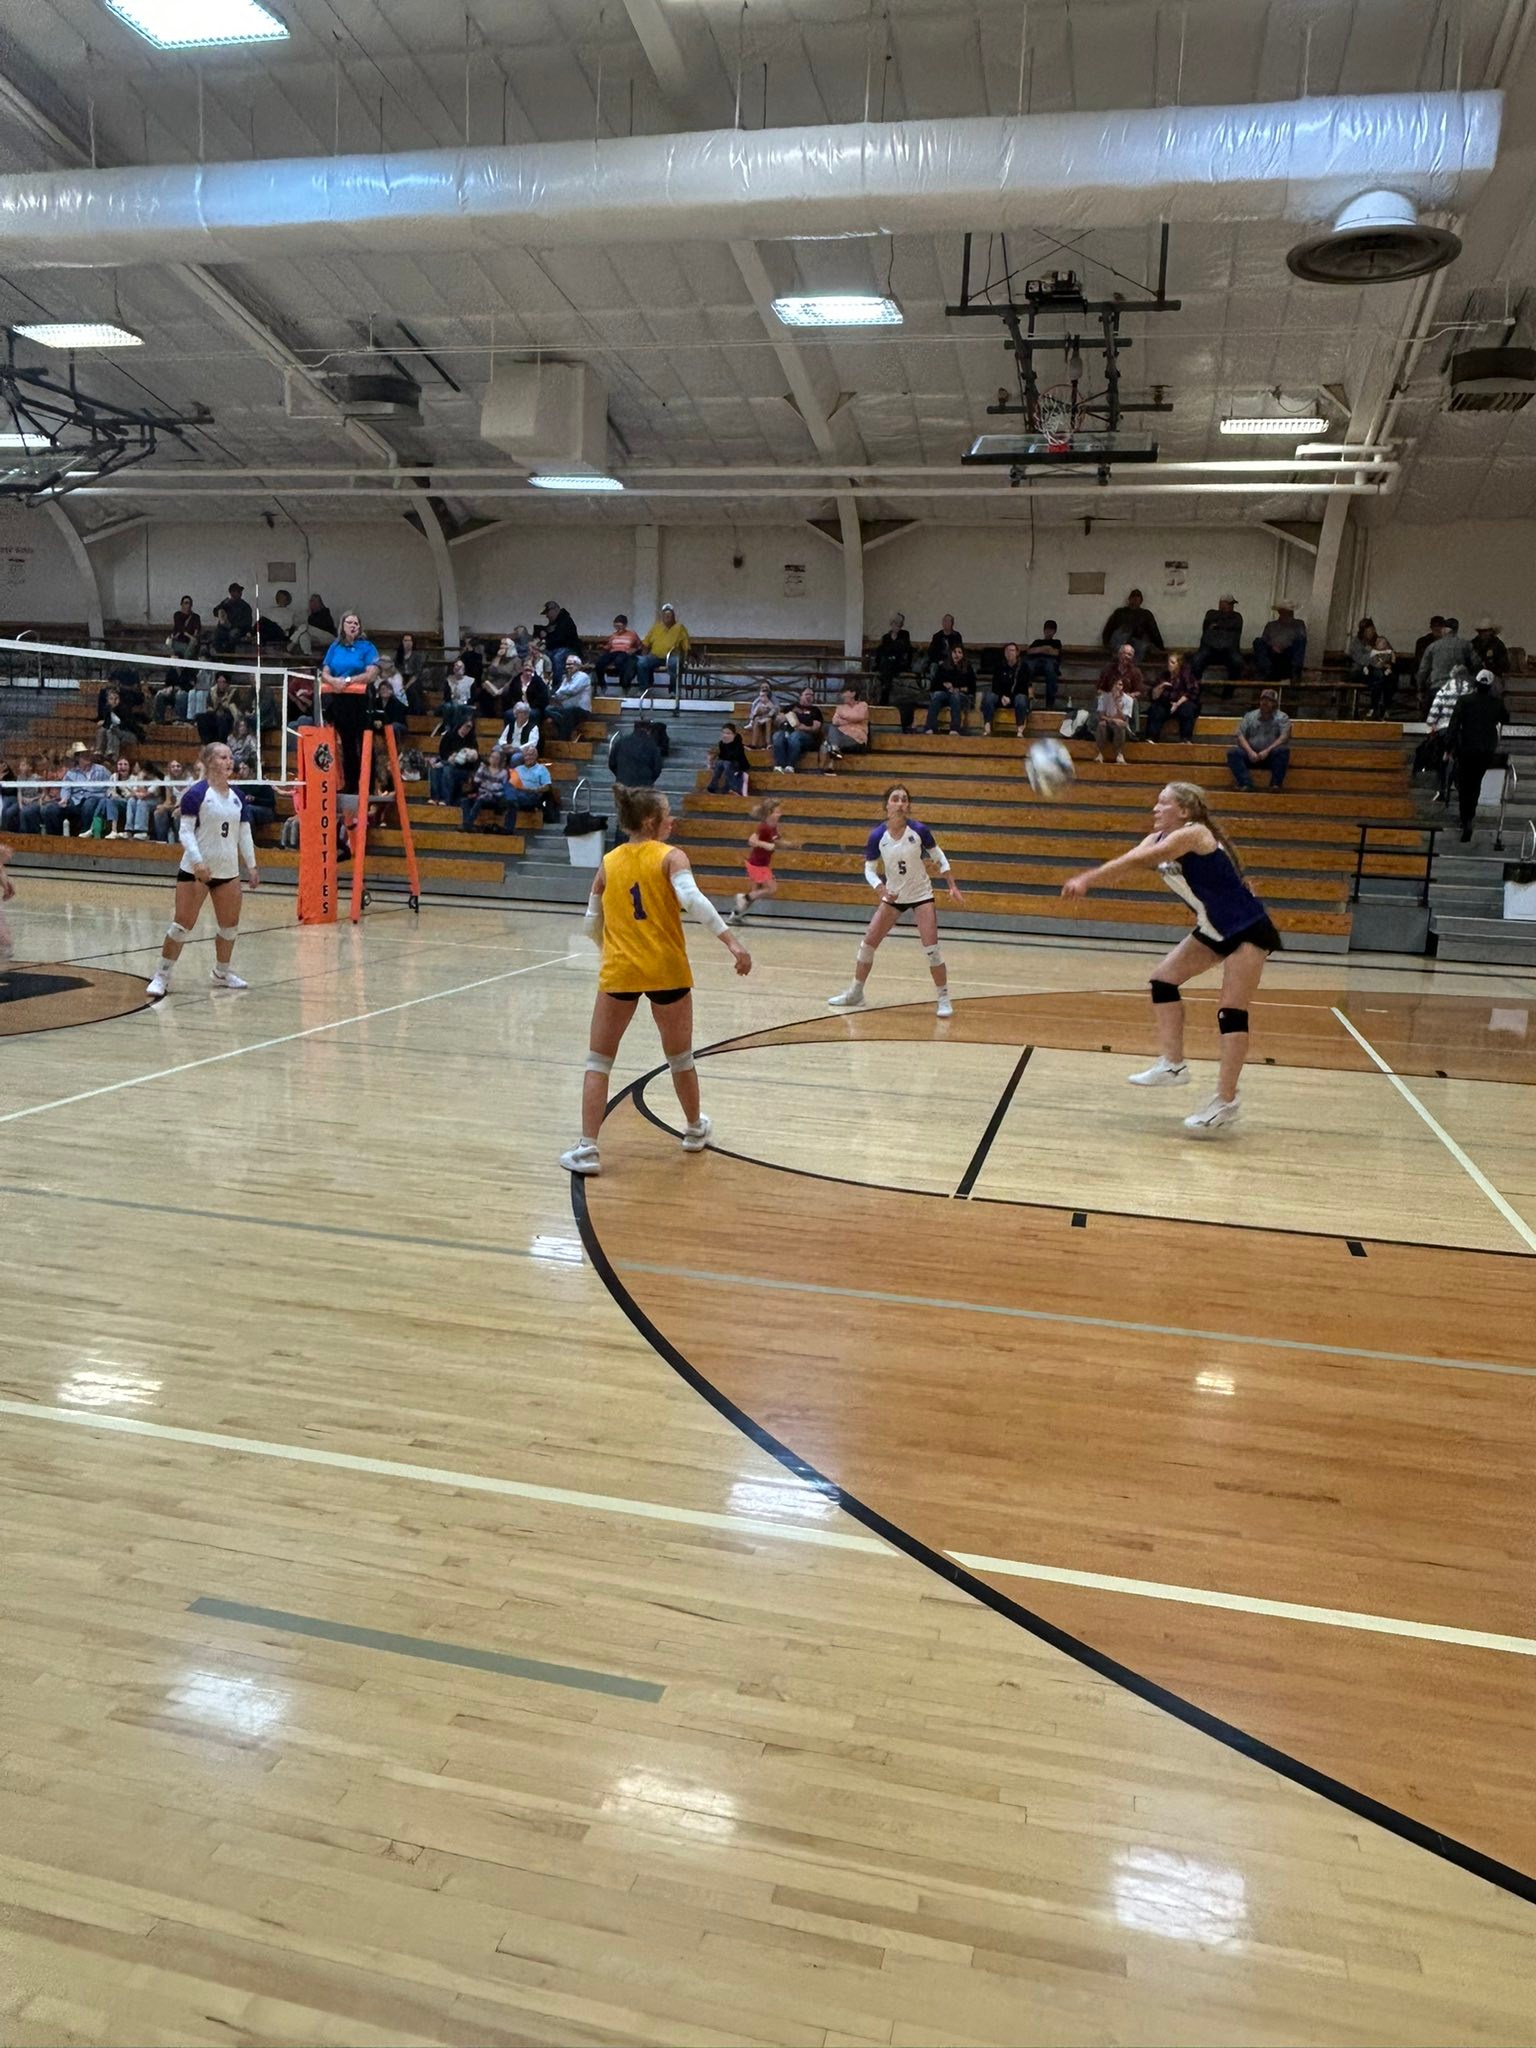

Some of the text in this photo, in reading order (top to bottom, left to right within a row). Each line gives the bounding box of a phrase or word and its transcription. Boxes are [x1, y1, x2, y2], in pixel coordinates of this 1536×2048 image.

[221, 821, 230, 838] 9
[320, 780, 329, 914] SCOTTIES
[897, 860, 907, 875] 5
[629, 881, 648, 920] 1
